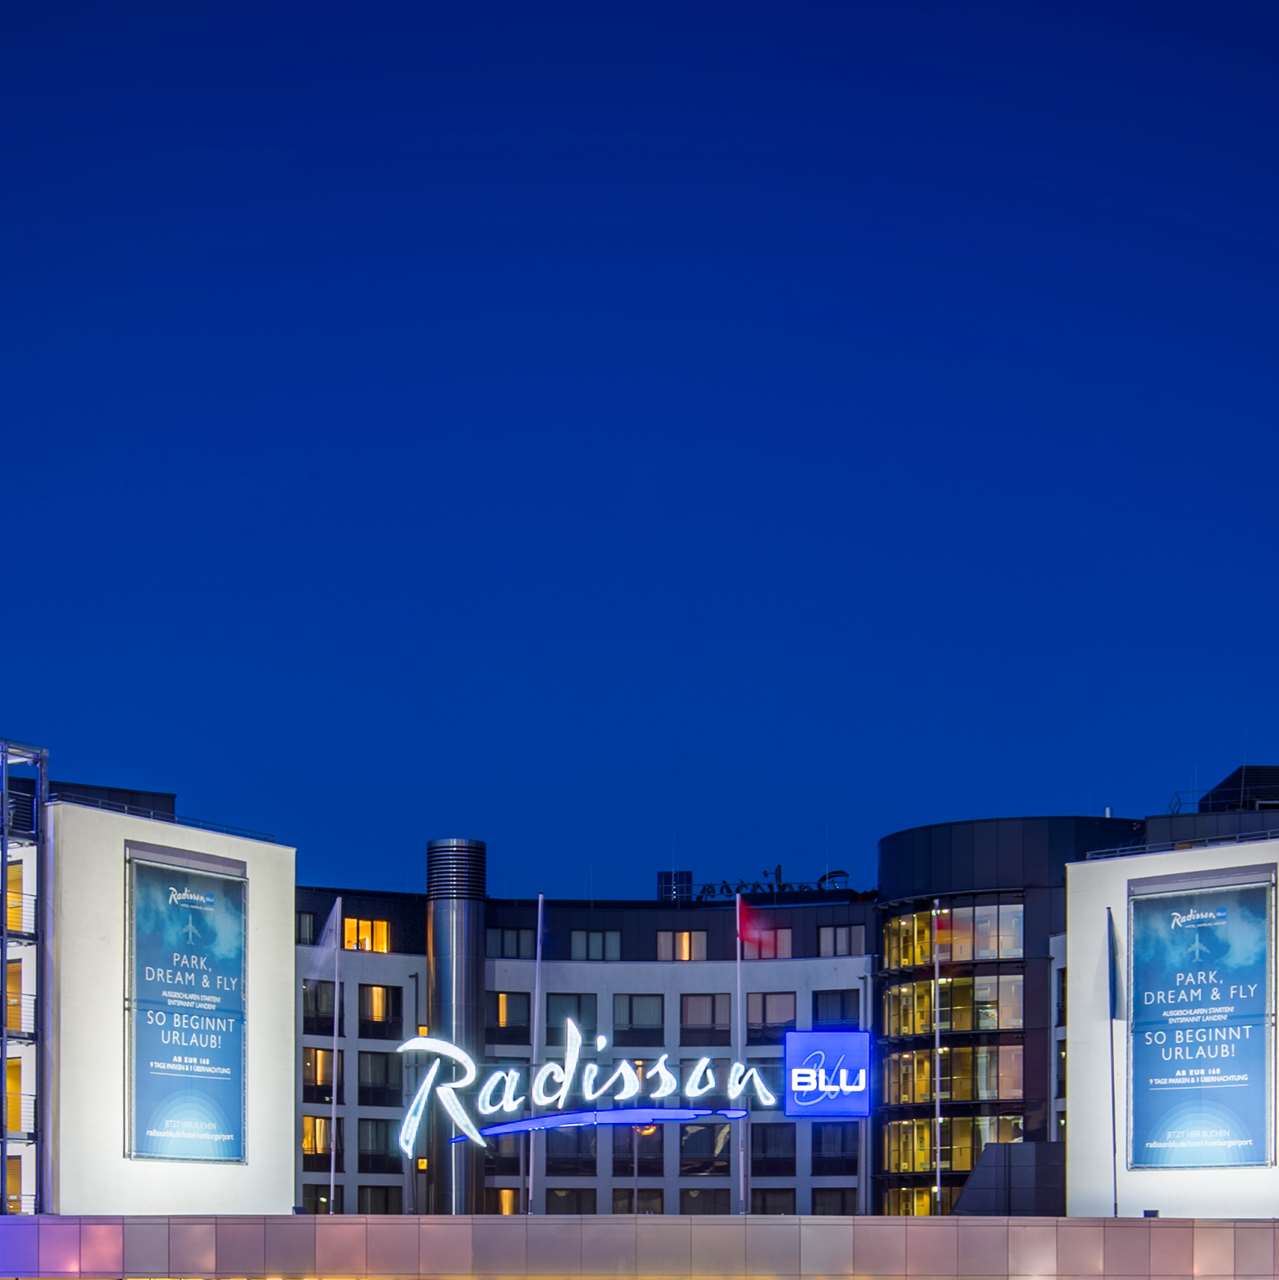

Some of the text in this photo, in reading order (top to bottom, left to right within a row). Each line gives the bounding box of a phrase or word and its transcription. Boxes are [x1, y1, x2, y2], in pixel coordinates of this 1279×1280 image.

[145, 966, 238, 991] DREAM & FLY
[1176, 970, 1223, 986] PARK.
[1144, 984, 1258, 1005] DREAM & FLY
[147, 1010, 235, 1032] SO BEGINNT
[161, 1029, 221, 1049] URLAUB!
[1145, 1025, 1252, 1045] SO BEGINNT
[1161, 1044, 1235, 1061] URLAUB!
[396, 1017, 866, 1159] Radisson BLU
